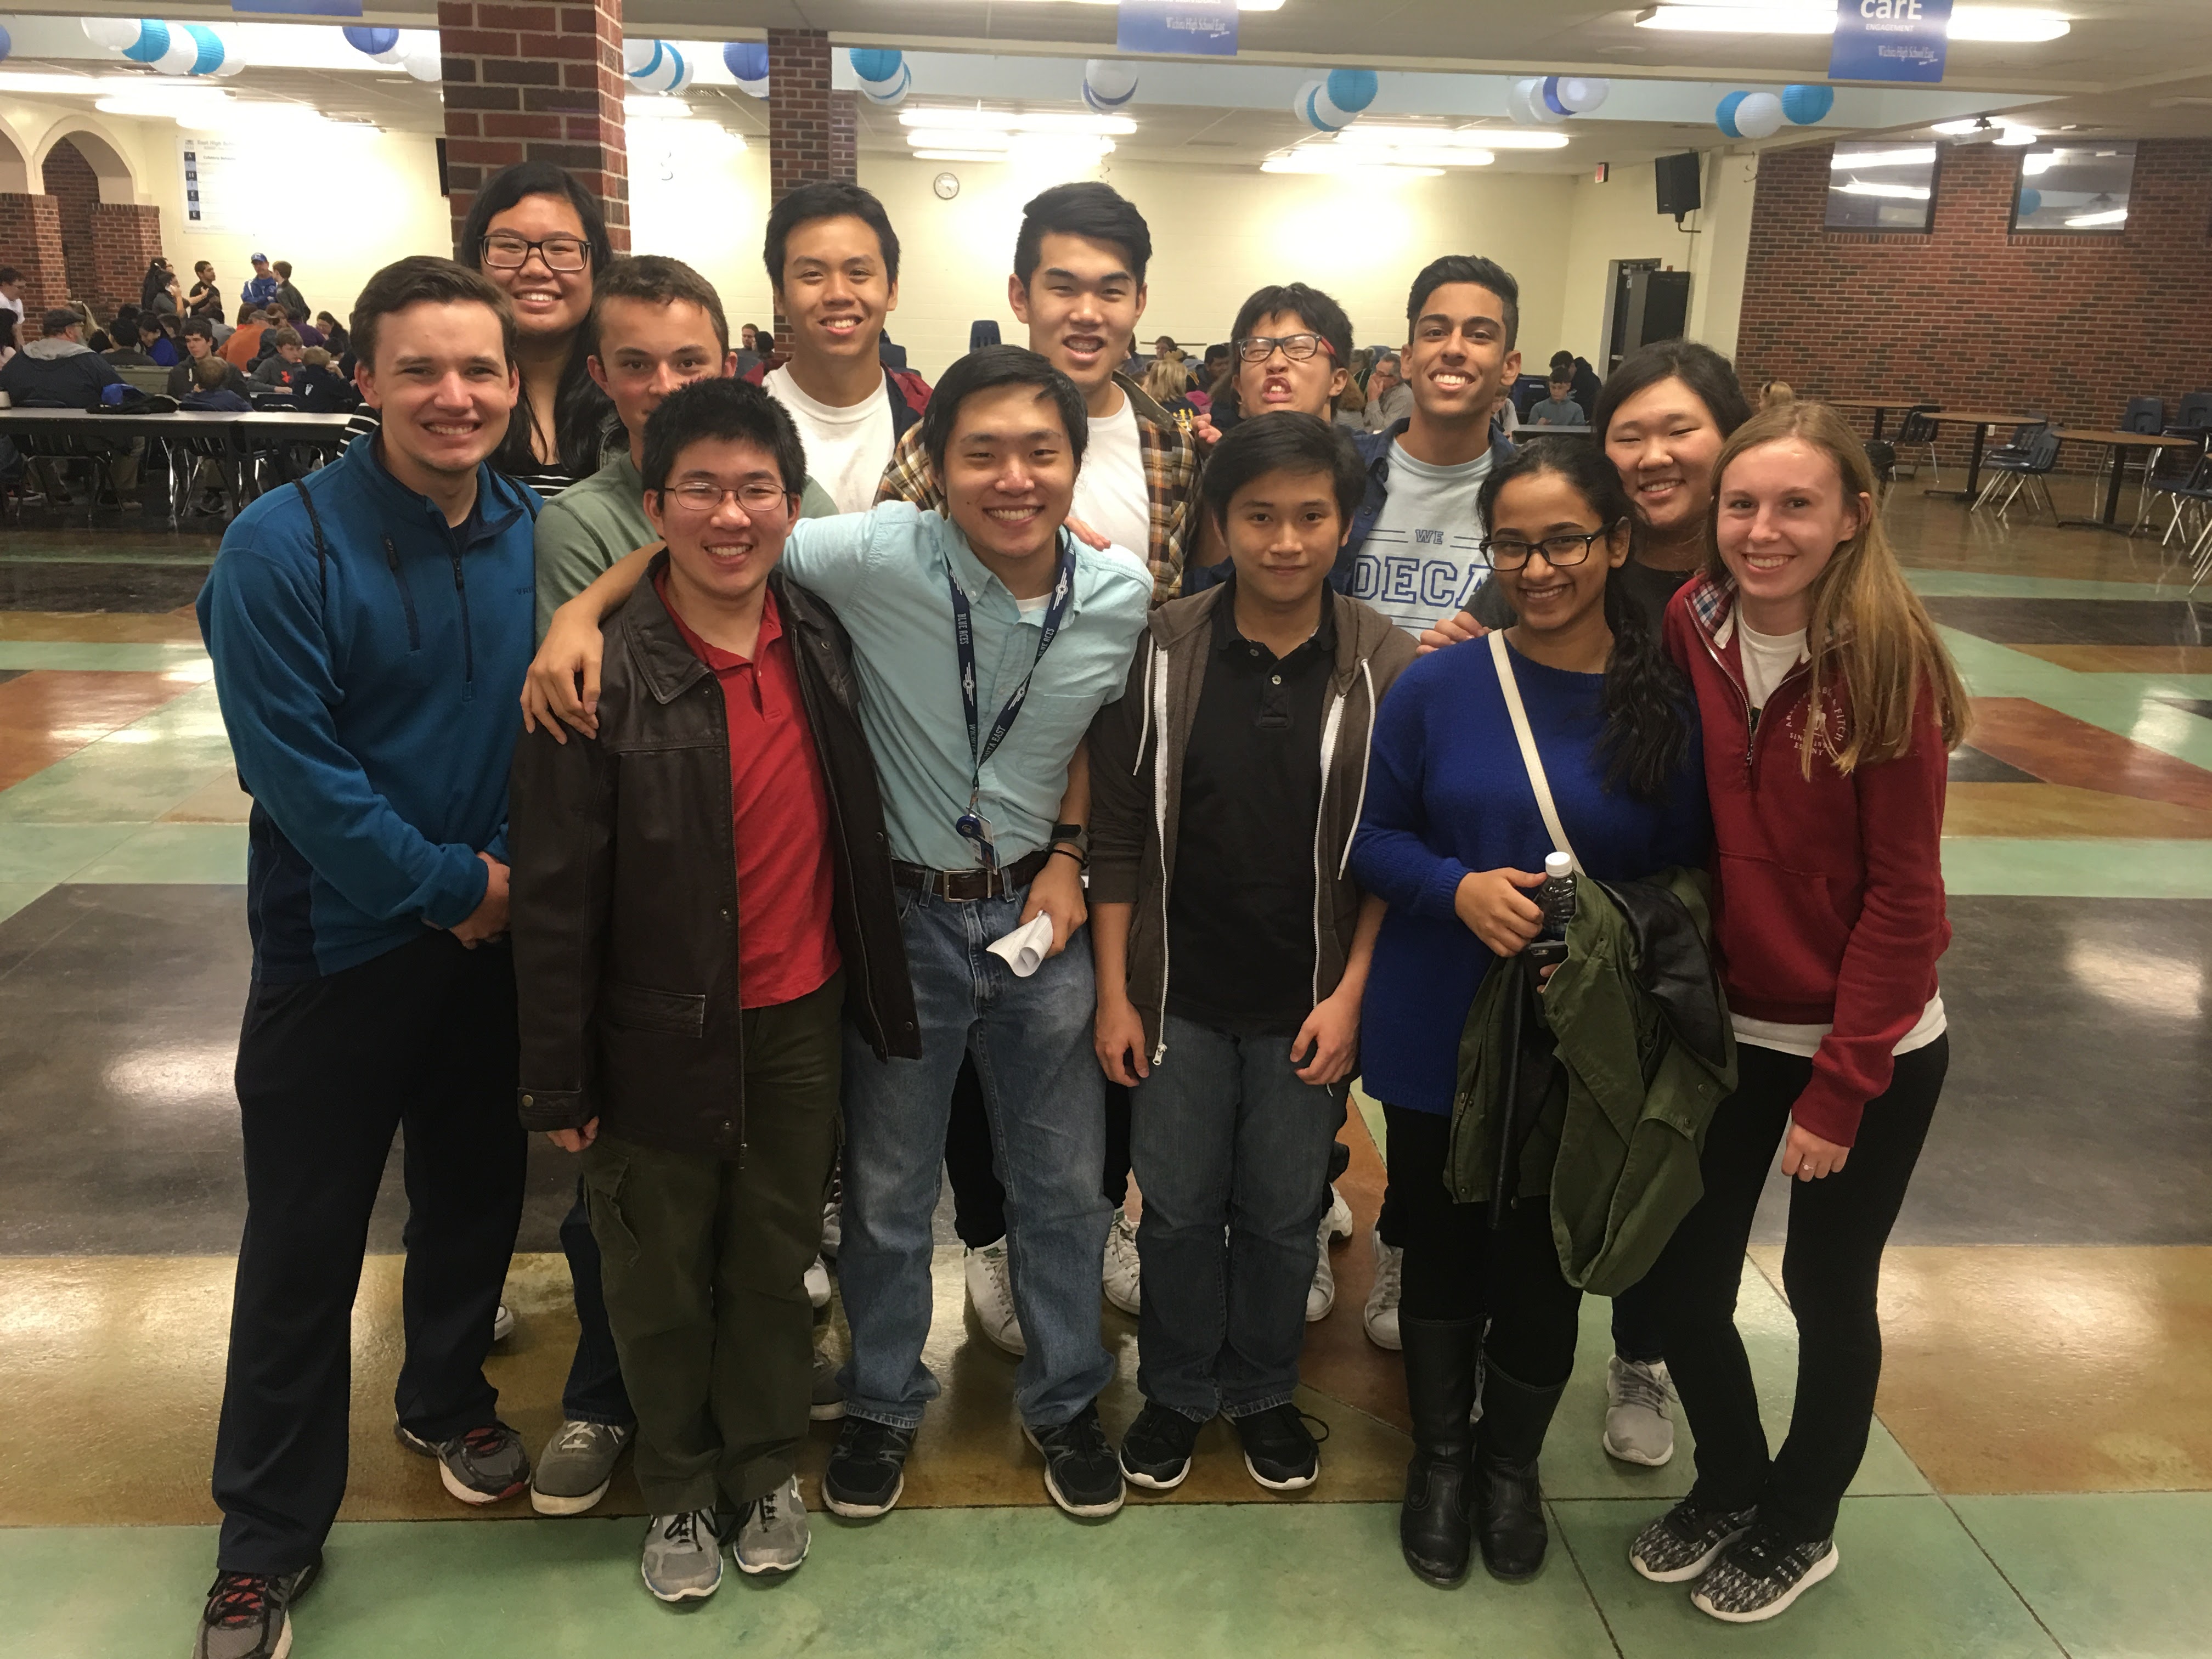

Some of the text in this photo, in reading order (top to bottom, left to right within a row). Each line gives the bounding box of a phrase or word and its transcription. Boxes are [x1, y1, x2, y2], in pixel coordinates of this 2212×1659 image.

[1865, 24, 1915, 32] ENGAGEMENT
[1415, 529, 1444, 545] WE
[1352, 554, 1491, 610] DECA
[957, 613, 969, 645] BLUE ACES
[1043, 627, 1055, 642] ACES
[1833, 707, 1846, 741] FITCH
[991, 725, 1006, 742] EAST
